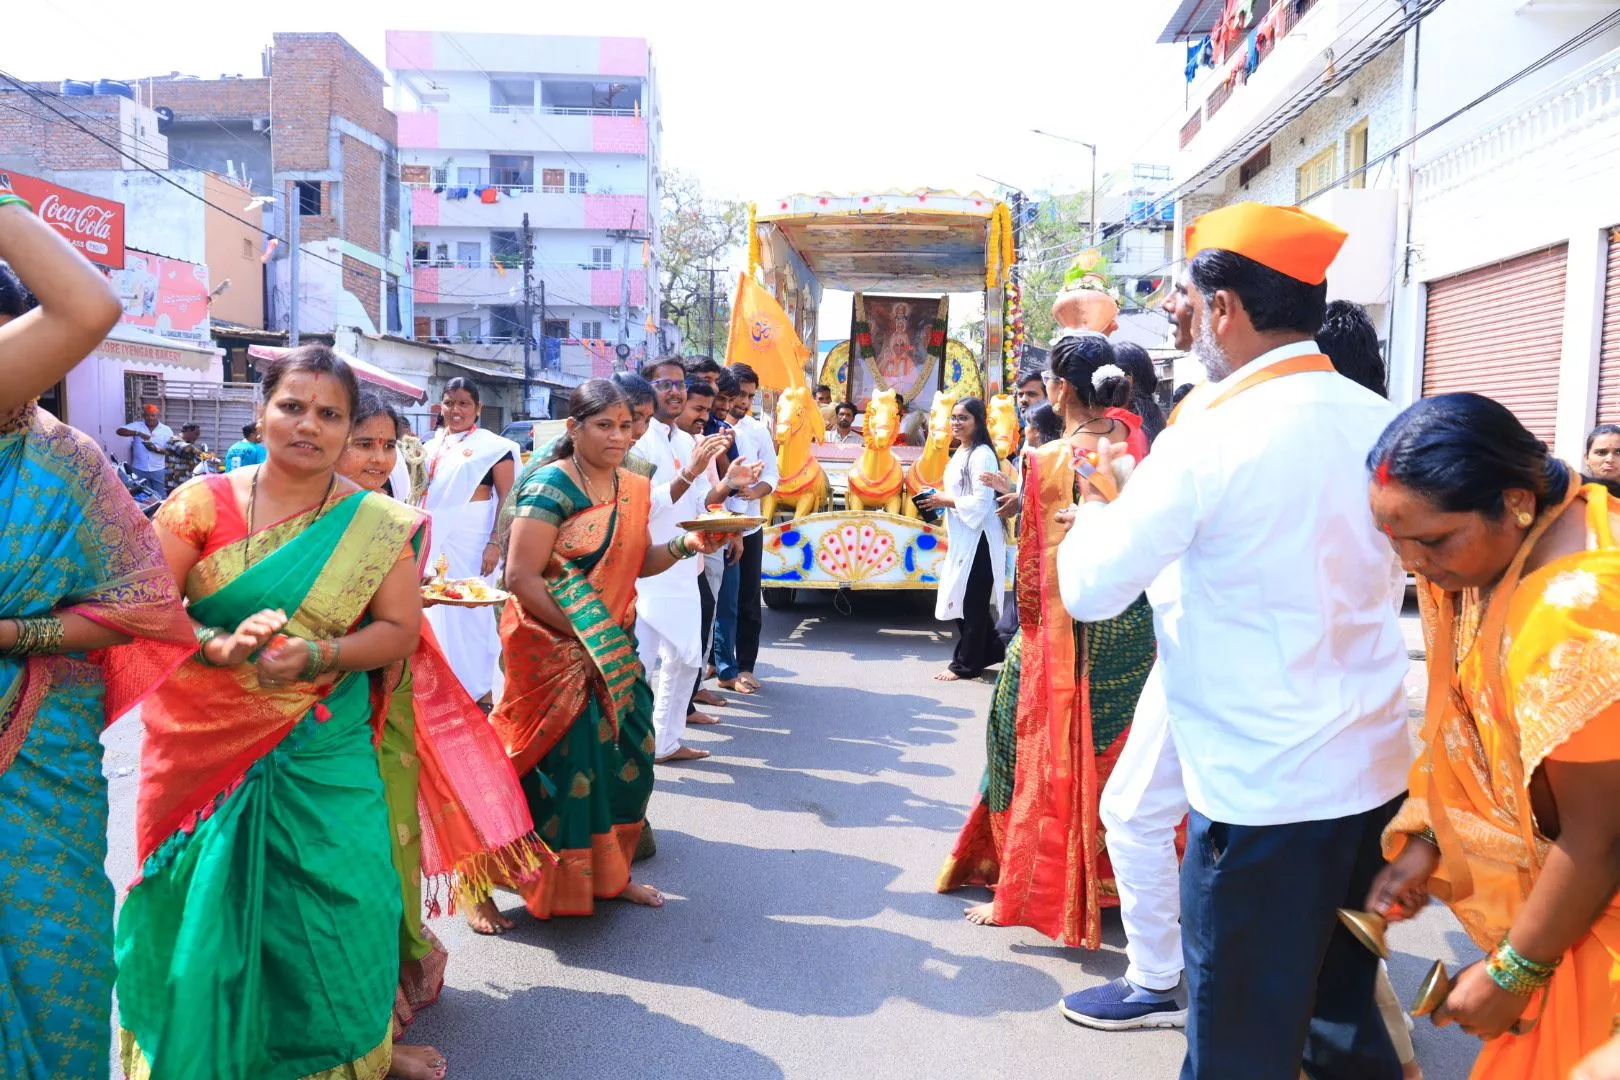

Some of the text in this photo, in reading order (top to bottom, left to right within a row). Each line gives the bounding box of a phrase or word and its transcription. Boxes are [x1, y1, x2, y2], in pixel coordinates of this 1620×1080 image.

[39, 194, 115, 239] Coca-Cola
[121, 343, 154, 358] IYENGAR
[154, 349, 181, 362] BAKERY
